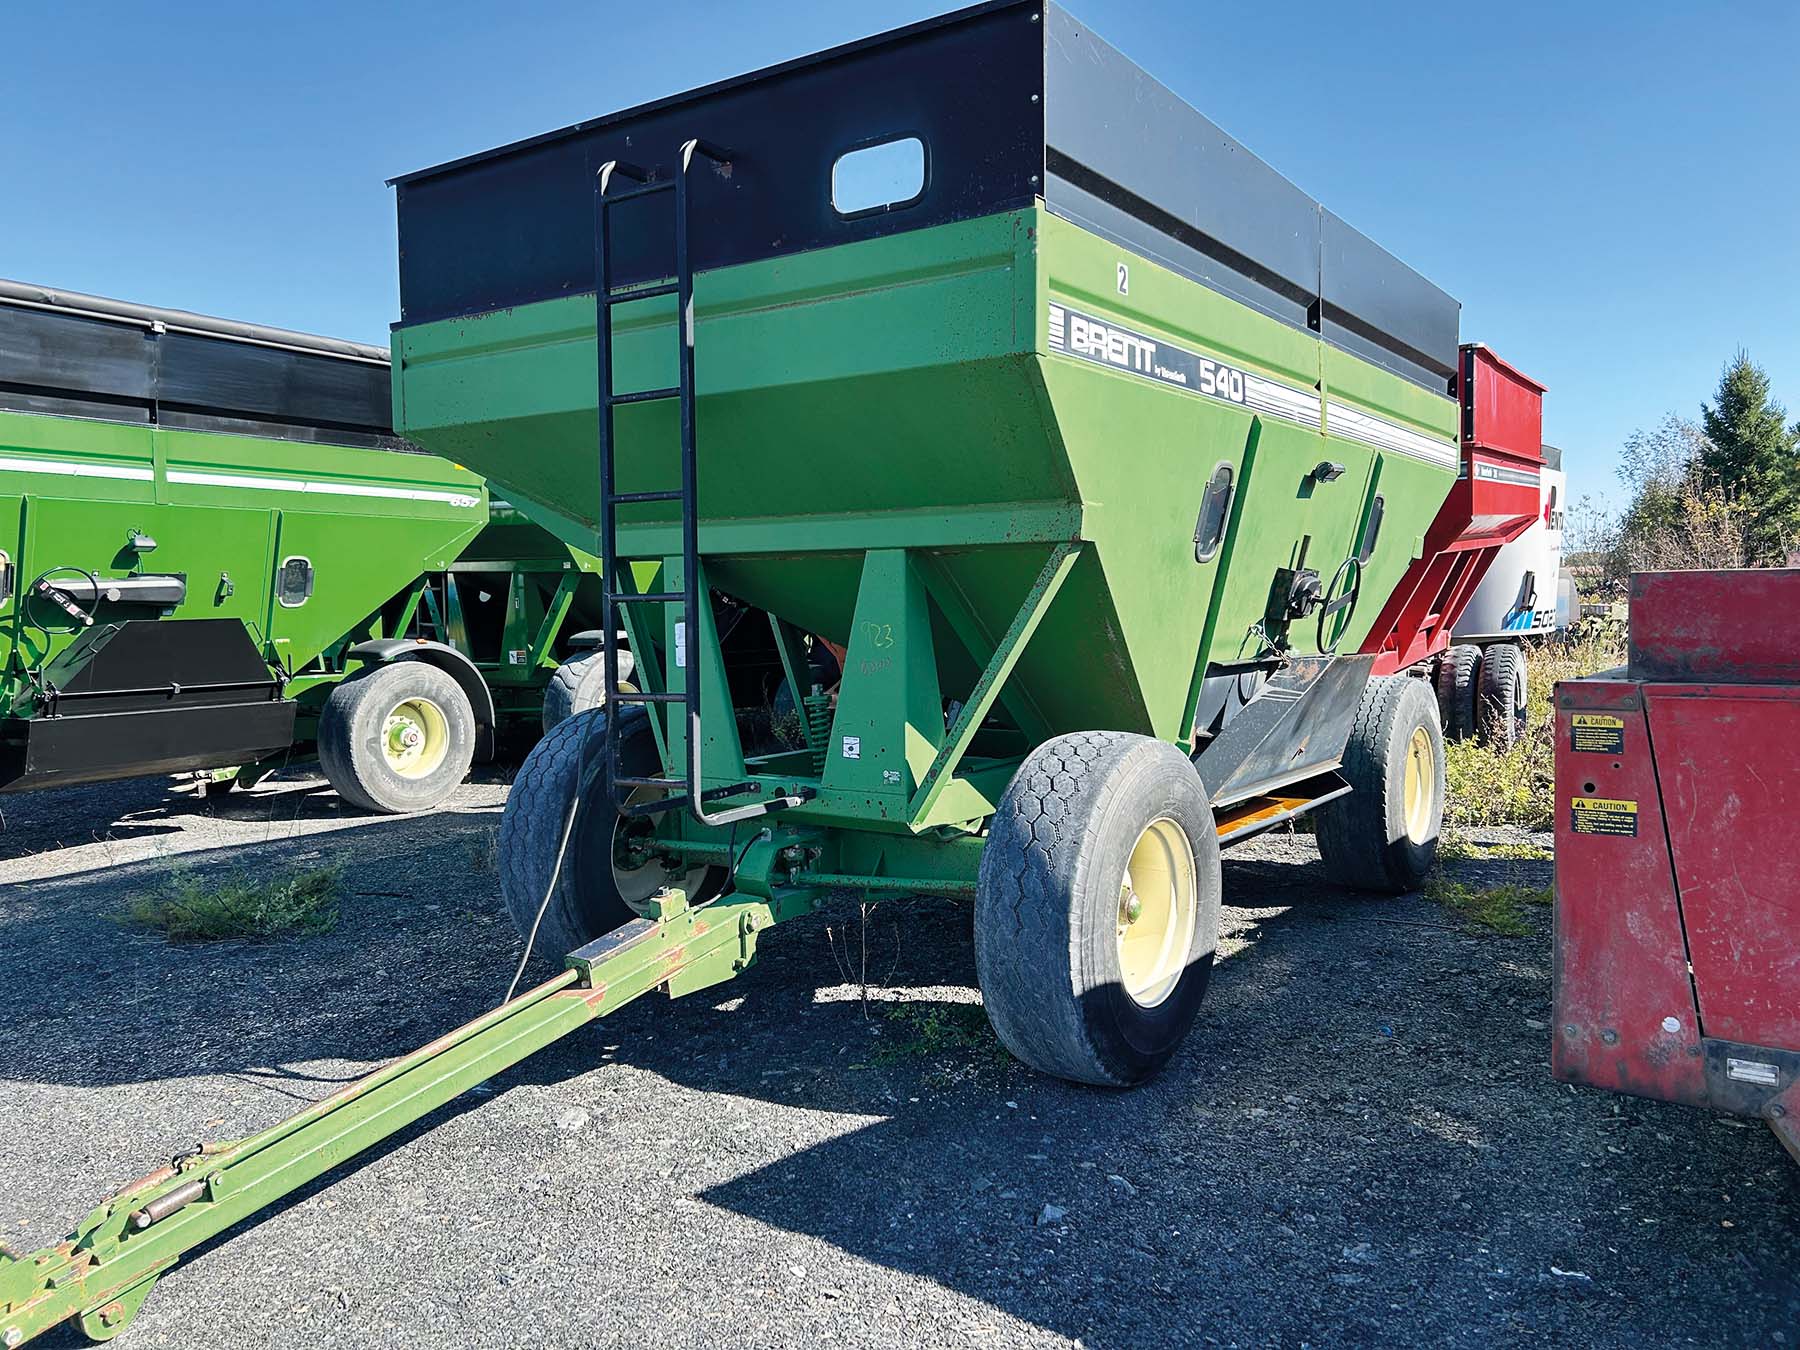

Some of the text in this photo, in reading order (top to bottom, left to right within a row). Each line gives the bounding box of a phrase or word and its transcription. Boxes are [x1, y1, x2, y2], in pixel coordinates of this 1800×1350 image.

[1118, 265, 1127, 294] 2
[1070, 315, 1156, 373] BRENT
[1200, 359, 1244, 402] 540
[1590, 718, 1617, 726] CAUTION
[1592, 802, 1628, 811] CAUTION
